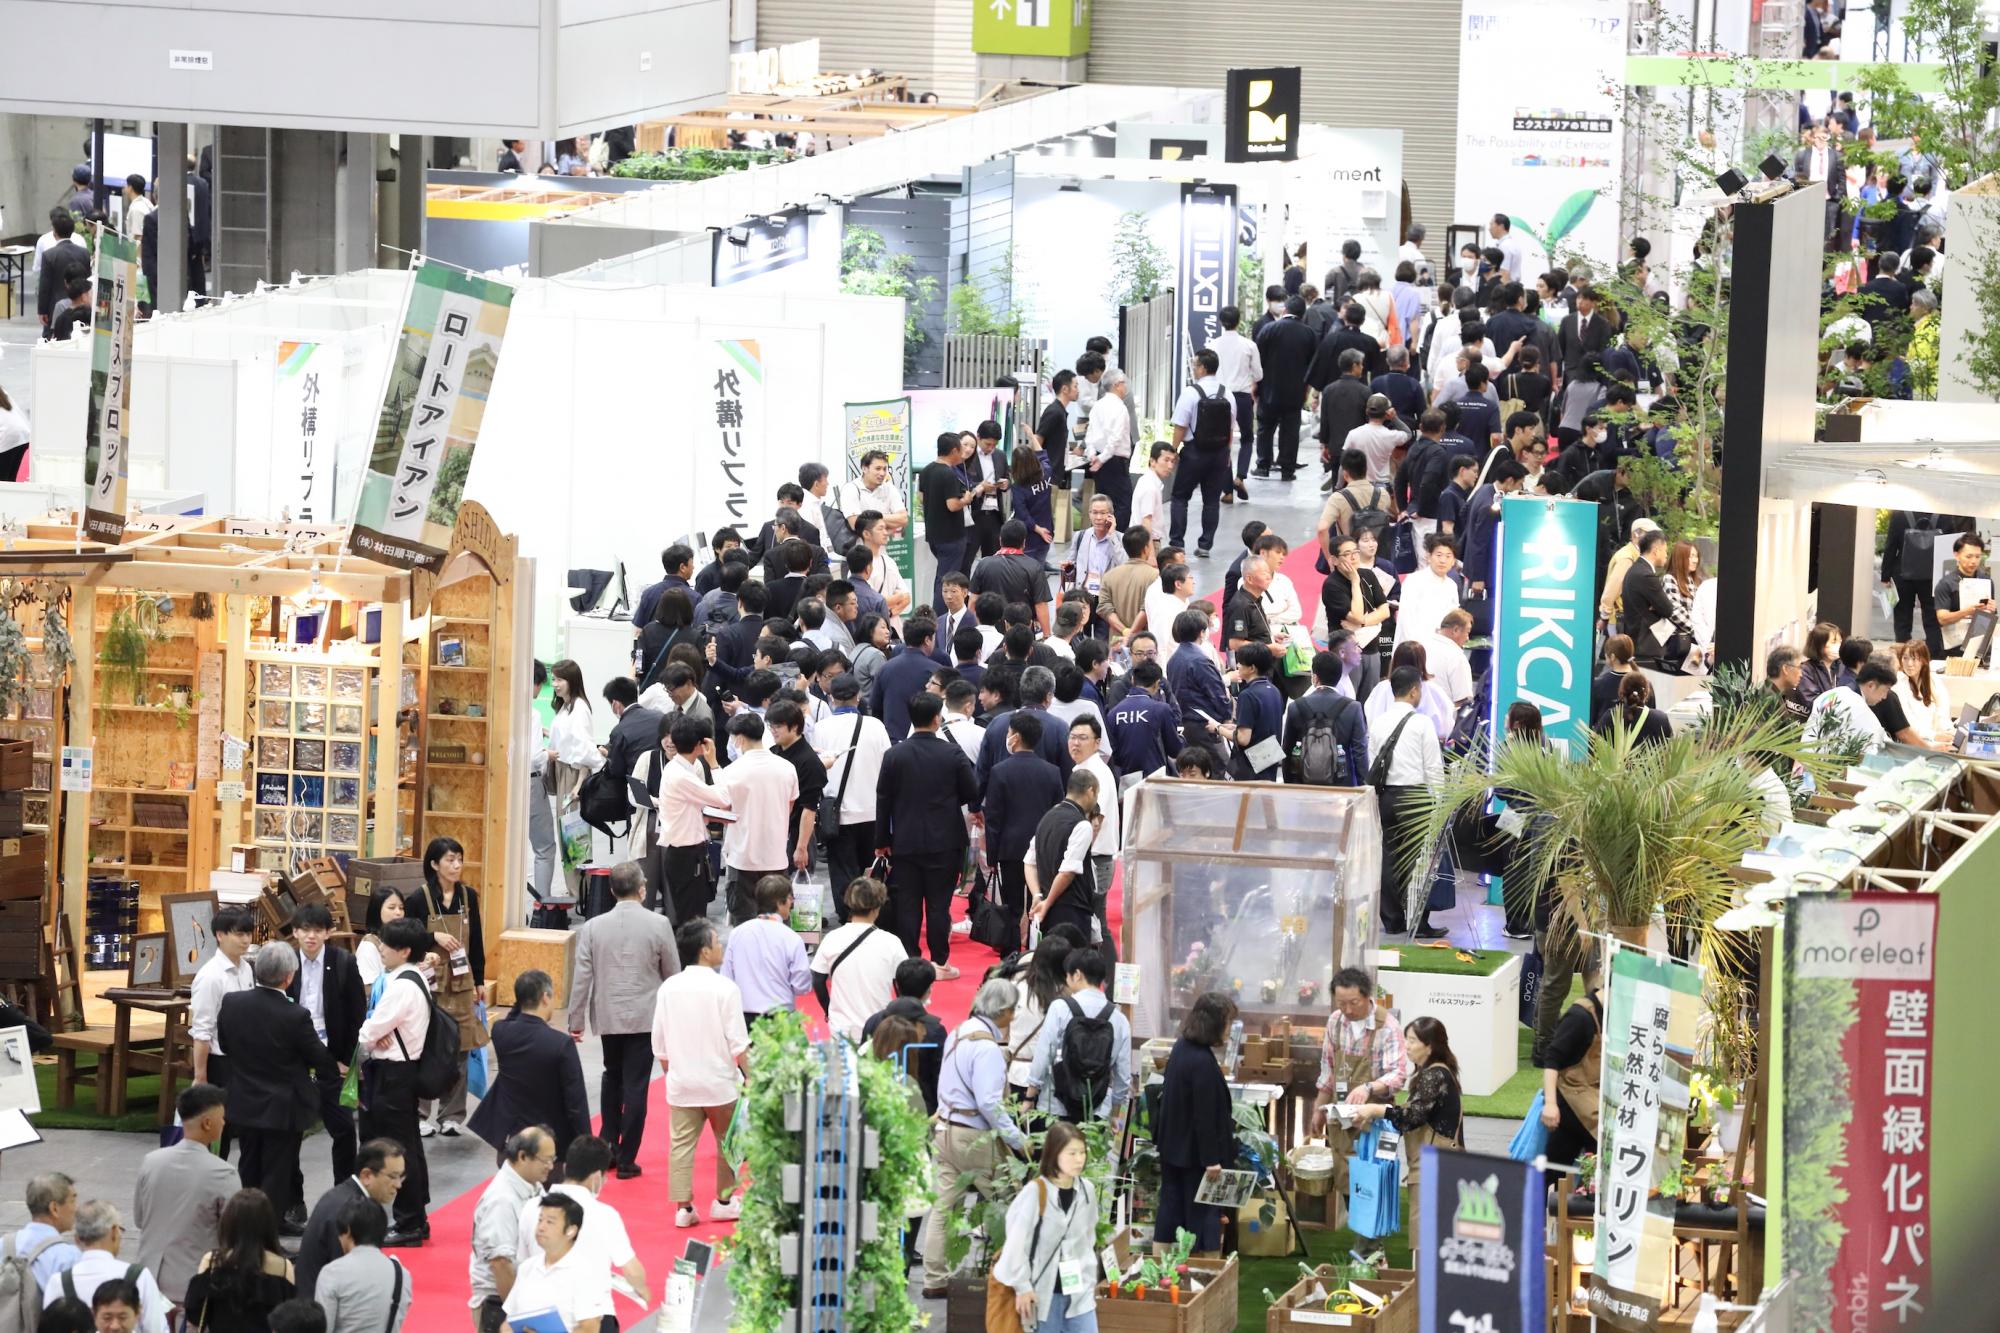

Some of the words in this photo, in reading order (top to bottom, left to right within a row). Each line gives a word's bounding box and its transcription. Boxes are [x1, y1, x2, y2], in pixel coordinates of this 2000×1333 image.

[1515, 119, 1610, 131] エクステリアの可能性
[1490, 136, 1545, 149] Possibility
[394, 312, 469, 519] ロートアイアン
[1031, 477, 1052, 496] RIK
[1116, 709, 1149, 725] RIK
[1803, 941, 1925, 965] moreleaf
[1643, 1007, 1670, 1107] 腐らない
[1617, 1024, 1649, 1131] 天然木材
[1608, 1143, 1647, 1263] ウリン
